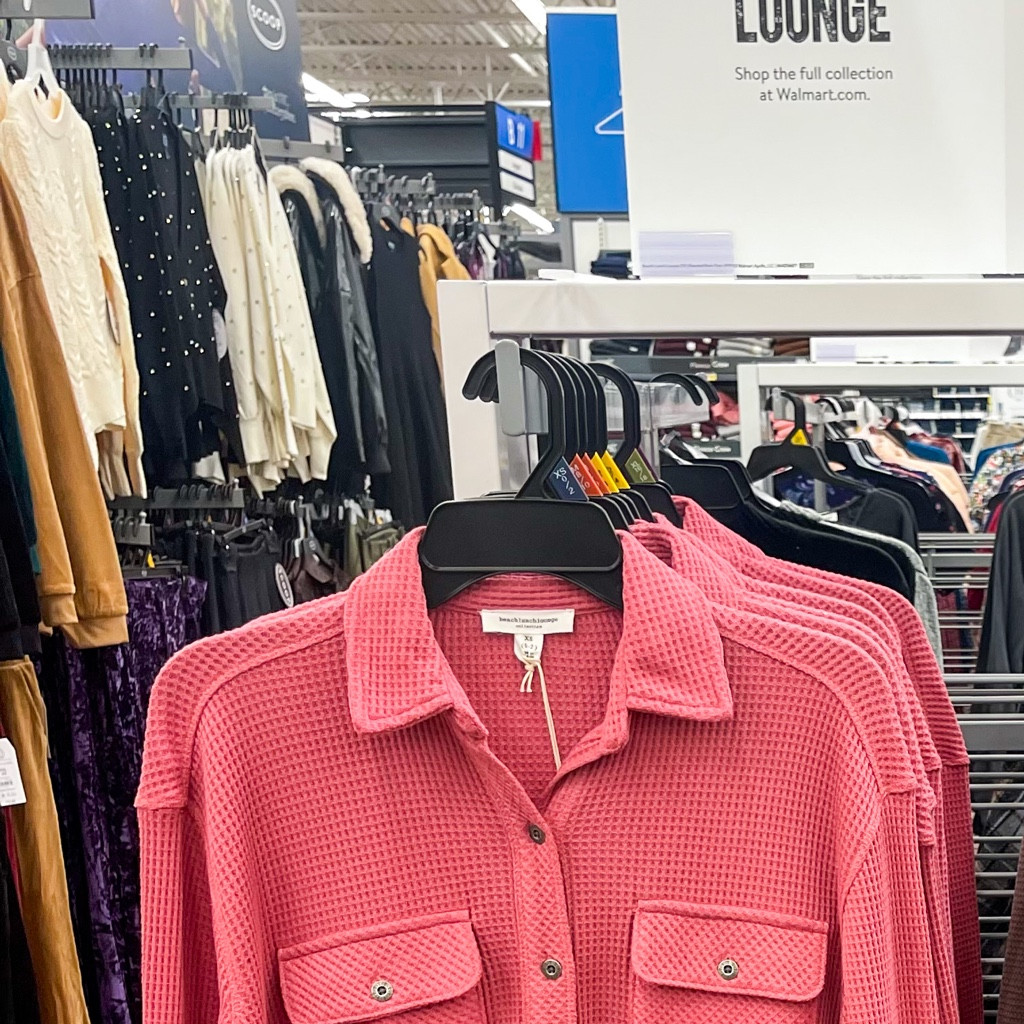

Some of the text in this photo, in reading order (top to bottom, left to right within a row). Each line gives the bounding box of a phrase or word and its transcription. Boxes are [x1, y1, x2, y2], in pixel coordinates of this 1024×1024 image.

[735, 0, 891, 43] LOUNGE
[734, 66, 893, 84] Shop the full collection
[759, 87, 870, 101] at Walmart.com.
